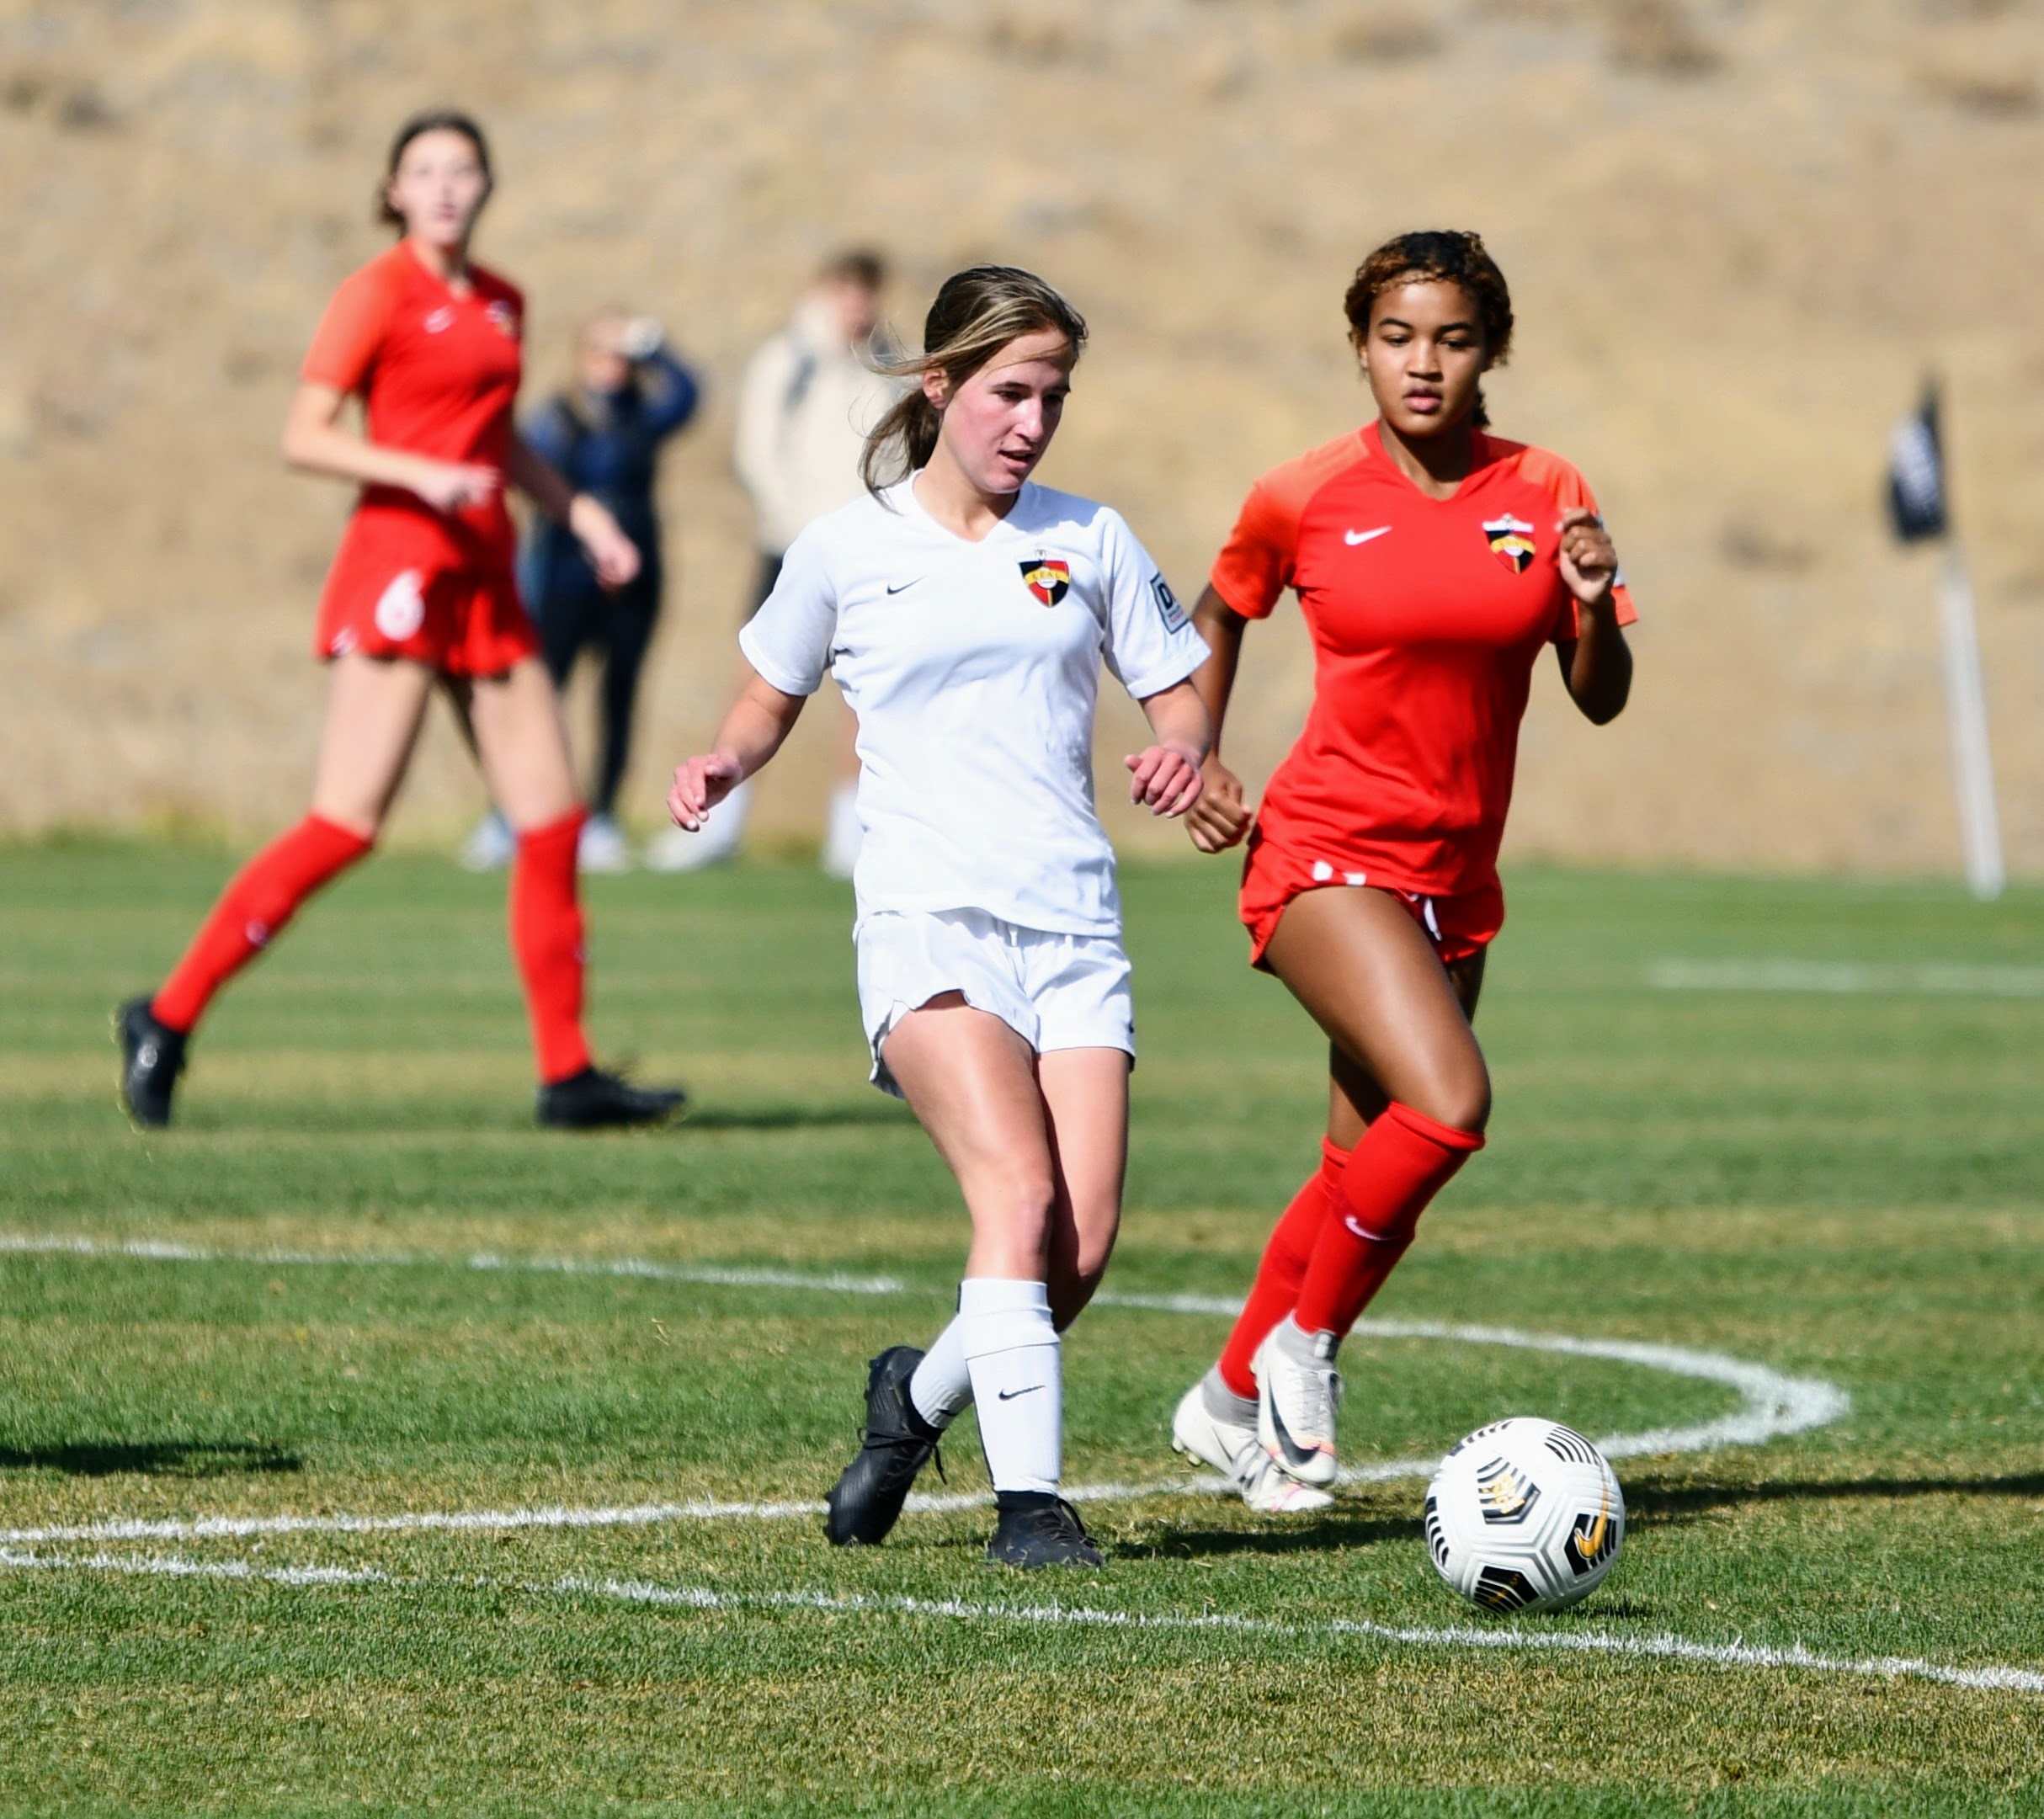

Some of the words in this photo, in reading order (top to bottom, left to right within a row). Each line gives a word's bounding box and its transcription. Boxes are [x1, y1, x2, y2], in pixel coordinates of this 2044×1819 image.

[1031, 572, 1060, 580] REAL
[374, 567, 425, 641] 6
[1158, 582, 1176, 609] D
